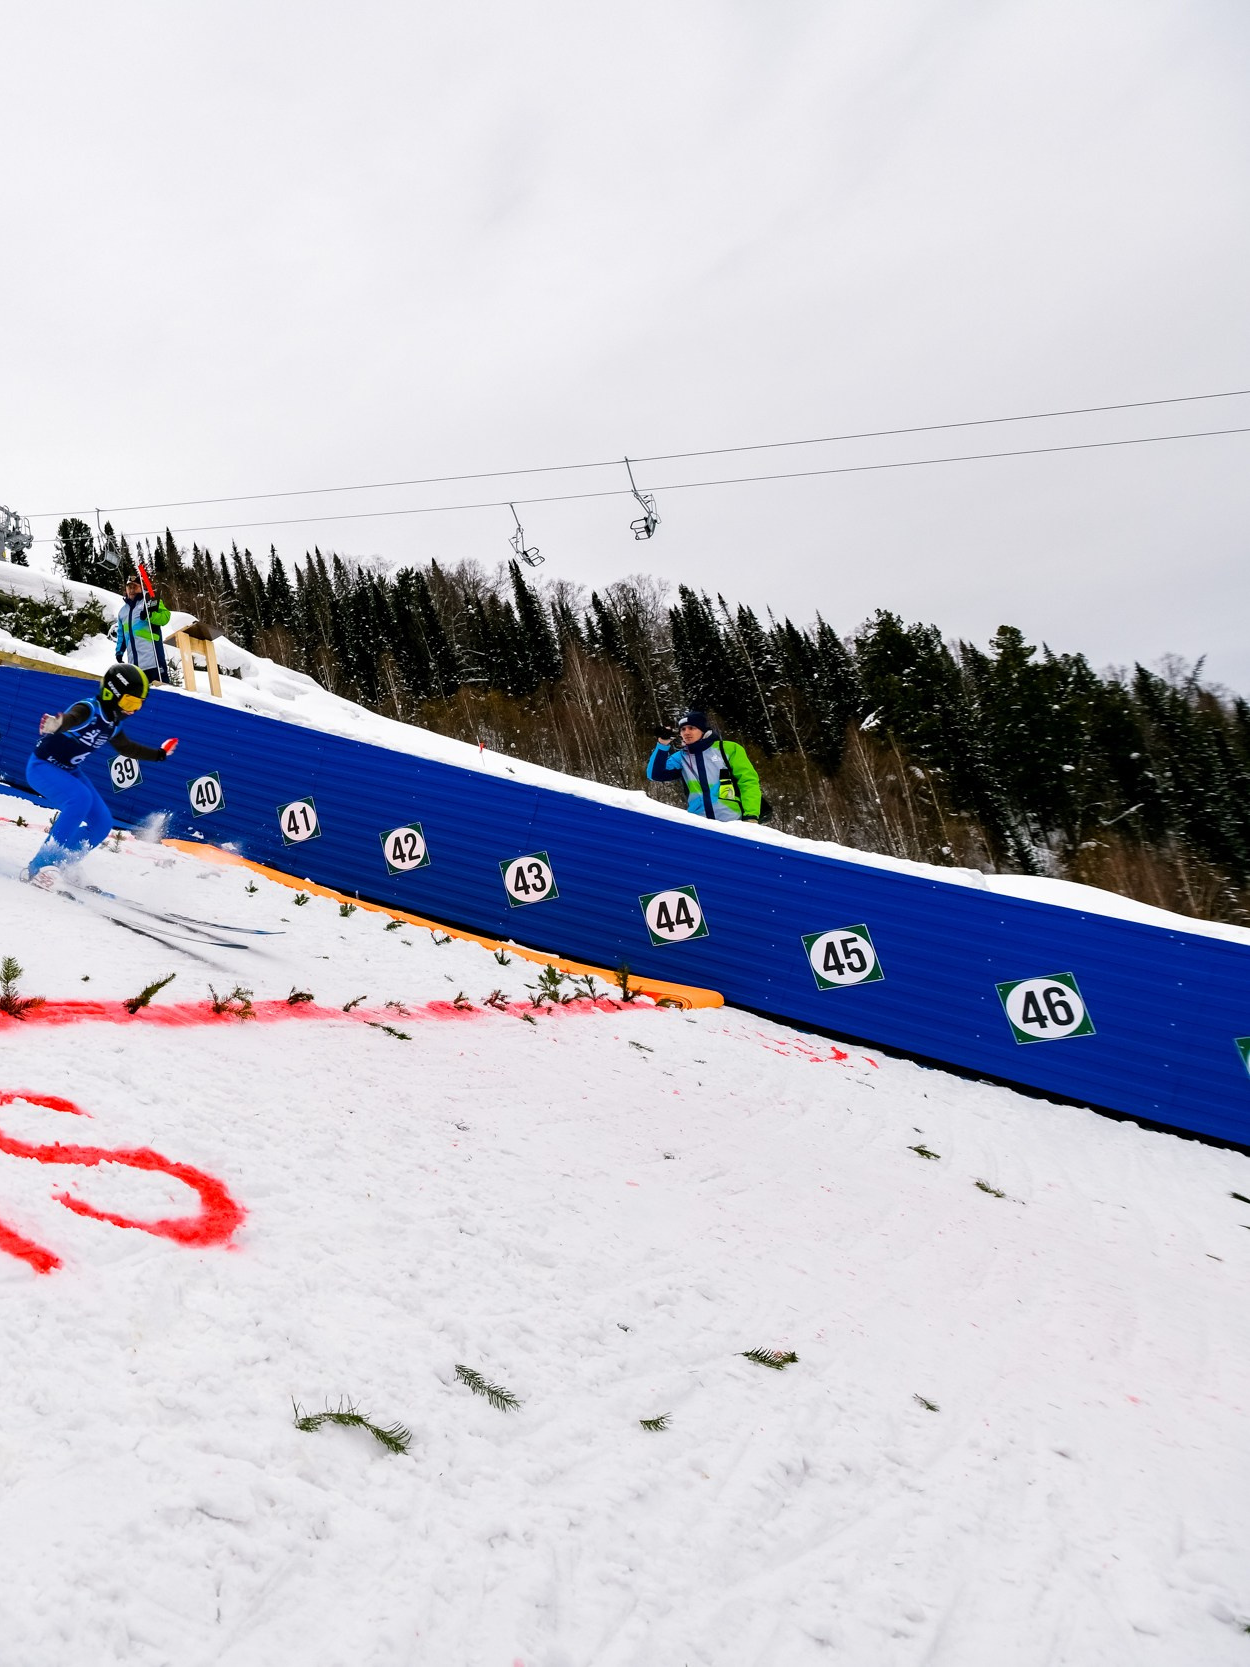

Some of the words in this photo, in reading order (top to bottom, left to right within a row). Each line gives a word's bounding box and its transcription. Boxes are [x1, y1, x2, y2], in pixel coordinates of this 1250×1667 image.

[114, 758, 136, 785] 39
[195, 780, 218, 807] 40
[287, 806, 311, 836] 41
[391, 832, 422, 864] 42
[513, 861, 547, 896] 43
[655, 897, 696, 933] 44
[822, 936, 868, 977] 45
[1021, 986, 1075, 1029] 46
